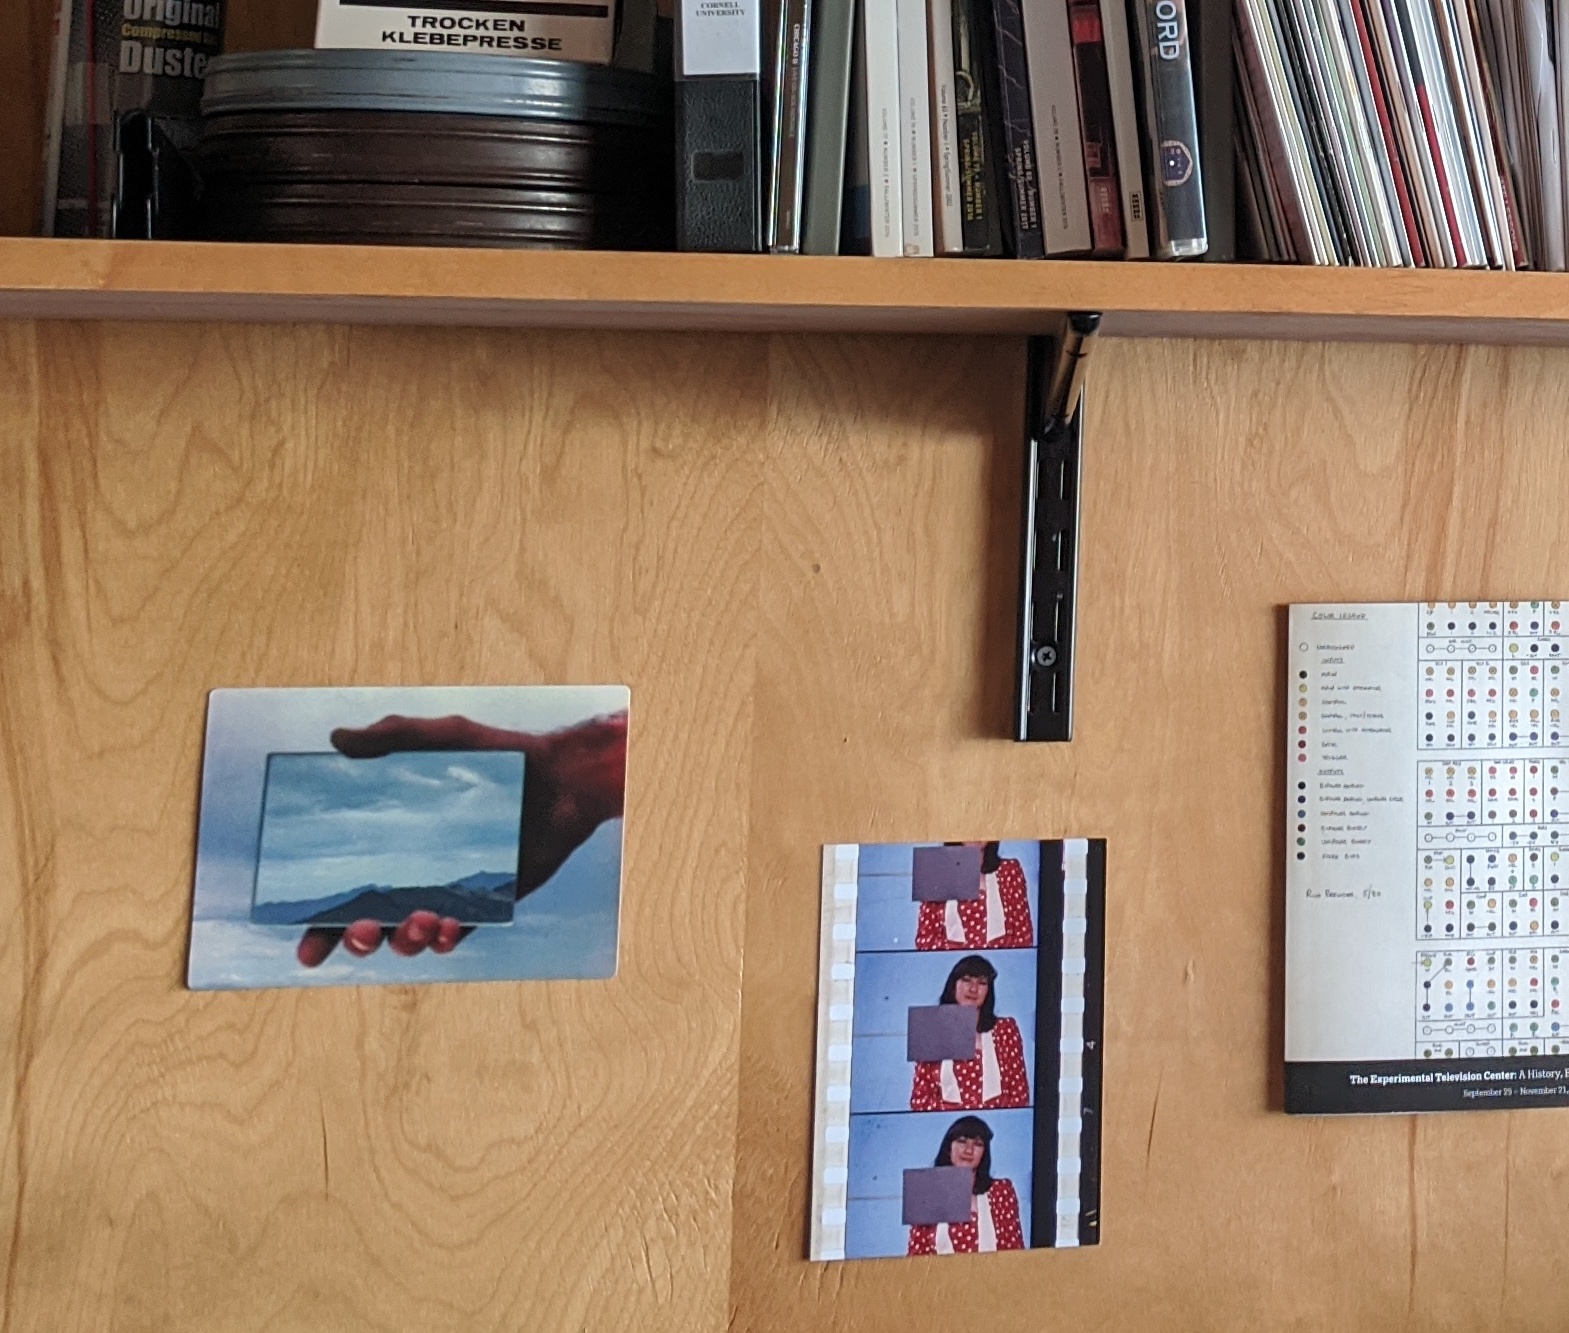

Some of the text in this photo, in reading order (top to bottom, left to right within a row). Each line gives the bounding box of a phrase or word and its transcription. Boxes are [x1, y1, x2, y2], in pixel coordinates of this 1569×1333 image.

[695, 8, 746, 17] UNIVERSITY
[407, 15, 525, 33] TROCKEN
[1155, 0, 1181, 60] ORD
[381, 30, 562, 52] KLEBEPRESSE
[1350, 1068, 1564, 1086] The Experimental Television Center: A History,
[1463, 1088, 1502, 1099] September
[1520, 1086, 1557, 1096] November
